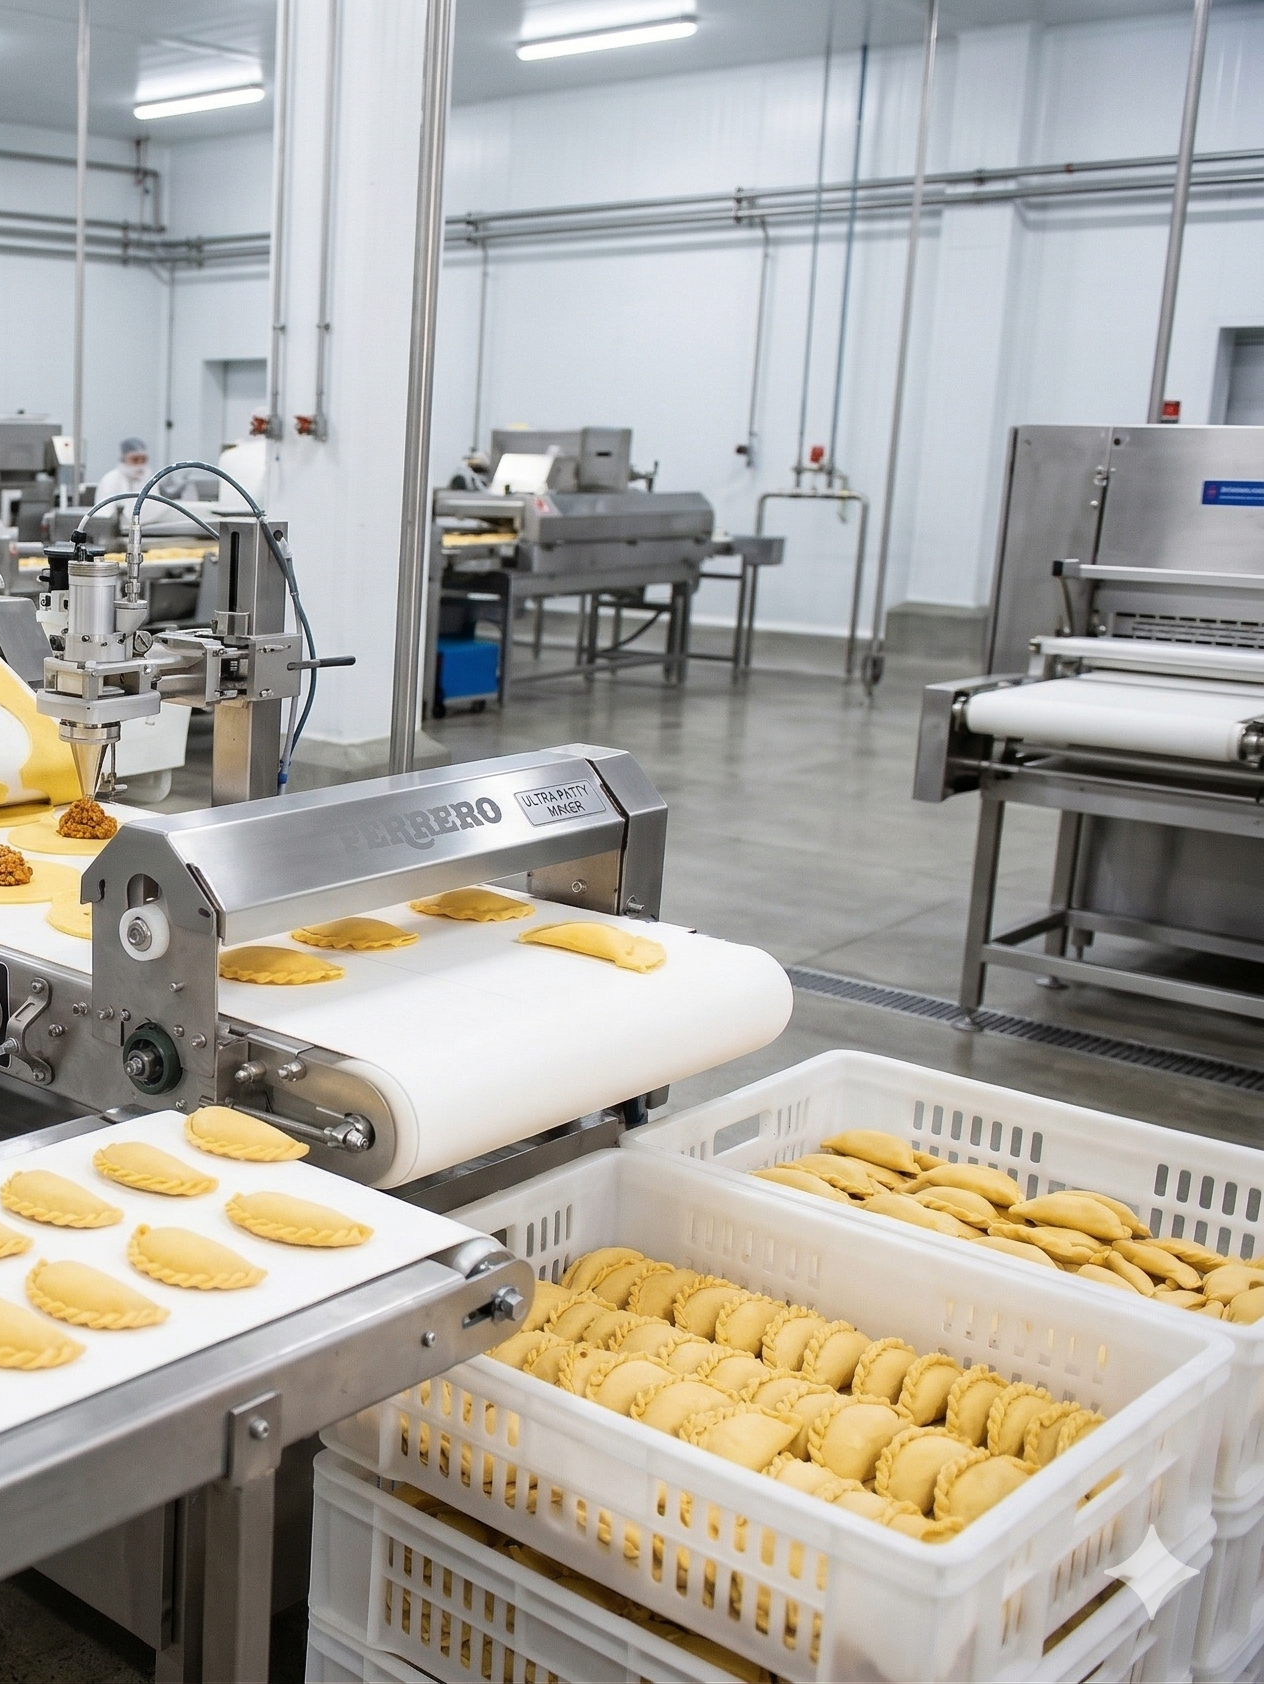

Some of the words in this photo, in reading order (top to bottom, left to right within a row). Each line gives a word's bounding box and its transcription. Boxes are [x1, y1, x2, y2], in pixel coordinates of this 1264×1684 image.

[521, 791, 558, 808] ULTRA
[556, 784, 589, 801] PATTY
[339, 797, 503, 850] FERRERO
